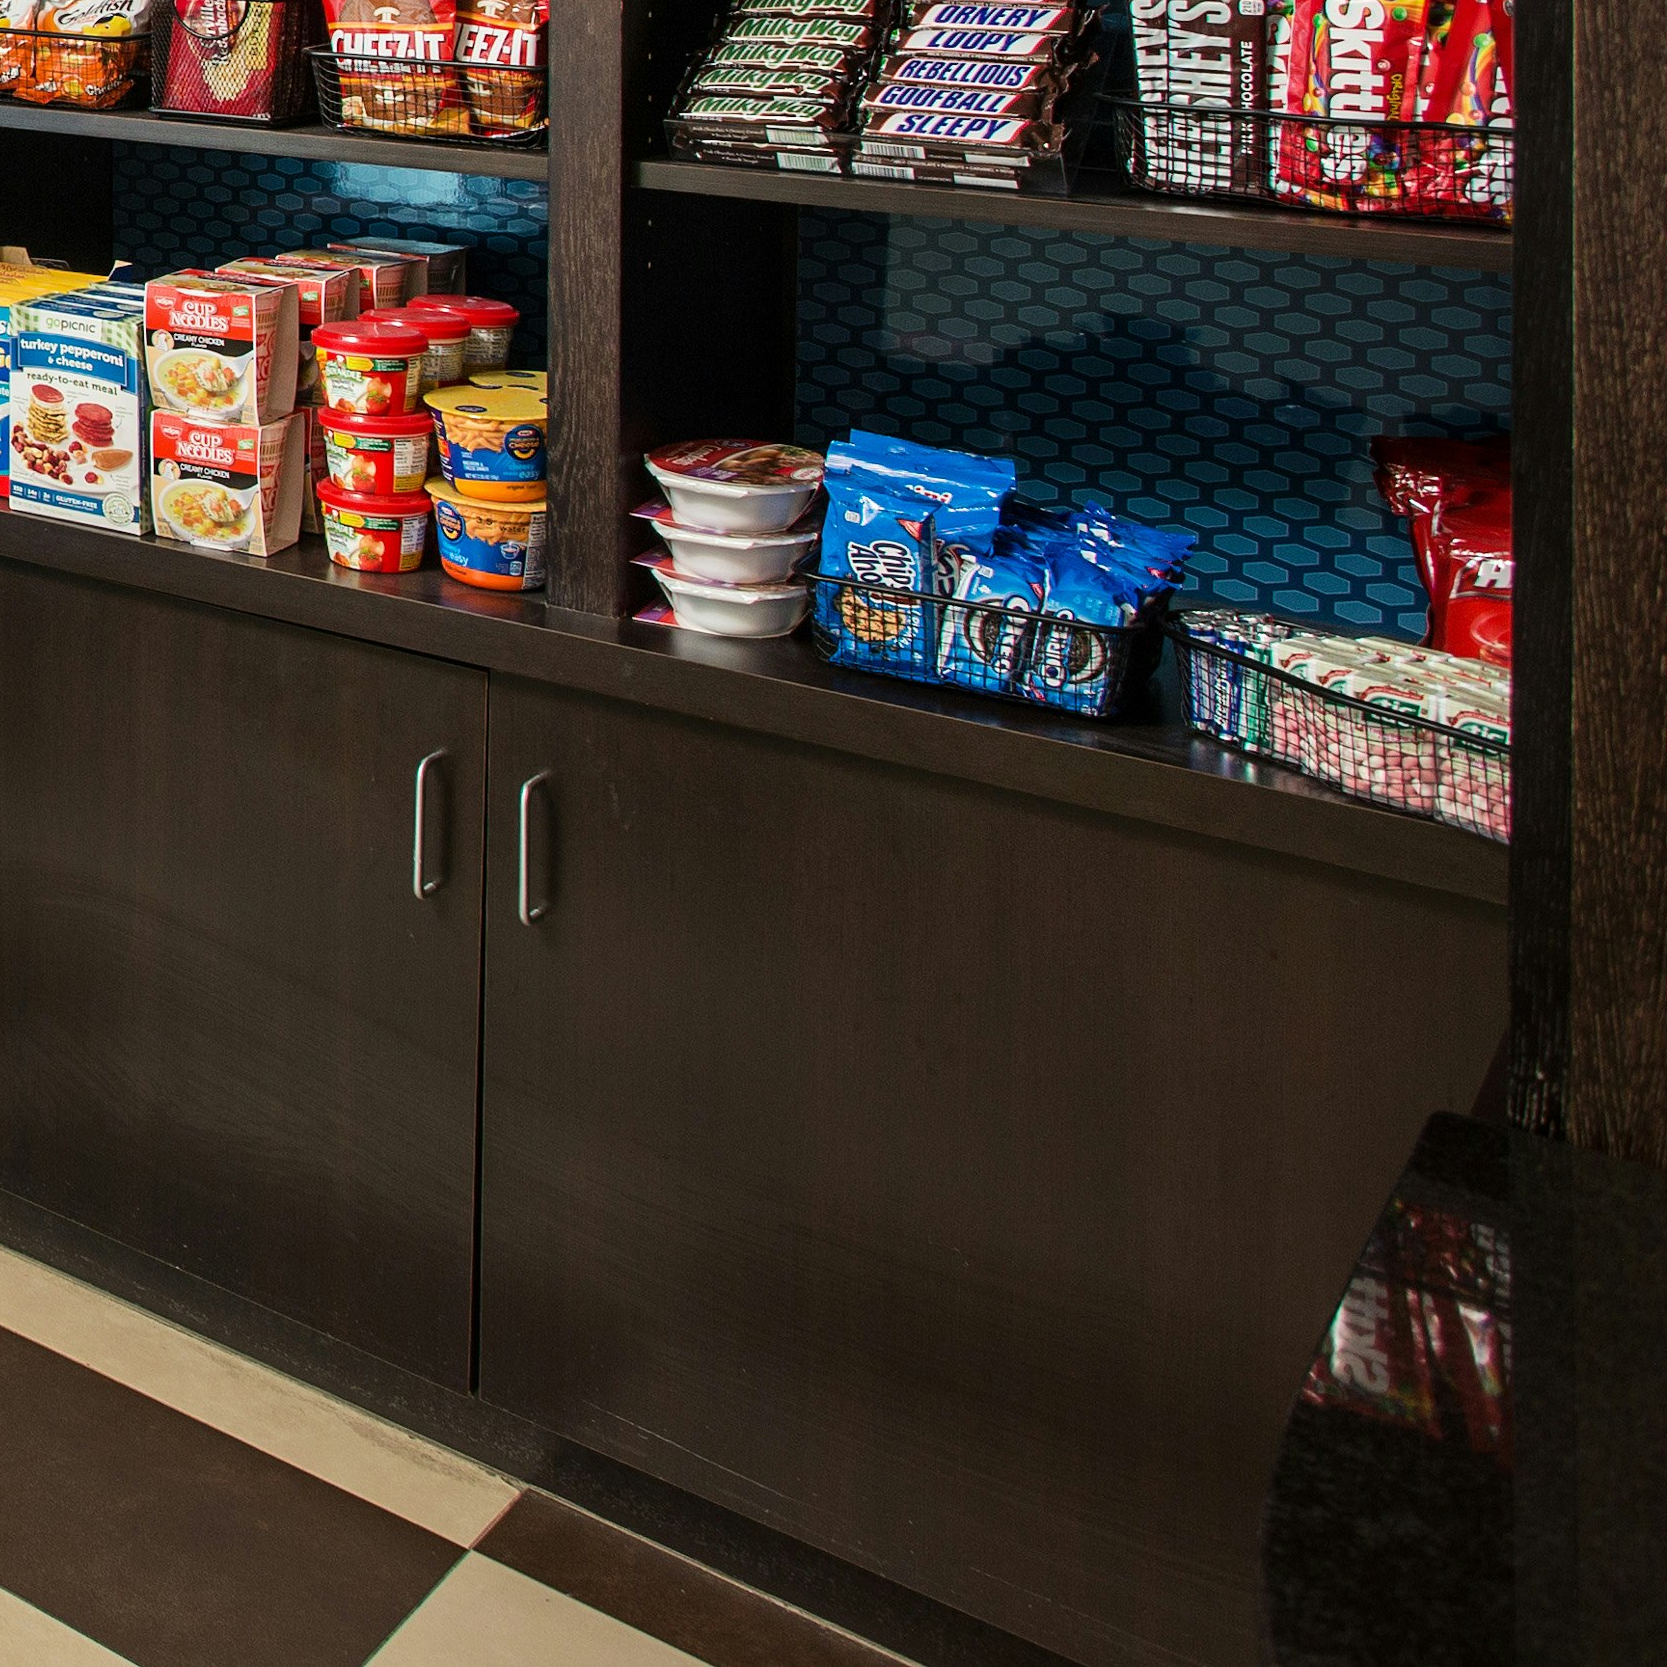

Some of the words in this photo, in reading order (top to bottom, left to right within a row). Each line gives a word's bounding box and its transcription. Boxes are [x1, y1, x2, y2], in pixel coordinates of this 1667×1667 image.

[935, 5, 1051, 28] ORNERY
[927, 30, 1027, 52] LOOPY
[898, 59, 1031, 85] REBELLIOUS
[880, 85, 1012, 113] GOOFBALL
[897, 113, 1012, 138] SLEEPY
[185, 300, 217, 319] CUP
[169, 310, 230, 333] NOODLES
[173, 333, 198, 346] CREAMY
[198, 336, 226, 348] CHICKEN
[19, 337, 58, 357] turkey
[59, 343, 124, 368] pepperoni
[55, 357, 94, 372] cheese
[26, 370, 89, 390] ready-to-eat
[91, 380, 118, 396] meal
[189, 431, 223, 451] CUP
[174, 443, 235, 466] NOODLES
[179, 463, 203, 476] CREAMY
[203, 467, 231, 480] CHICKEN
